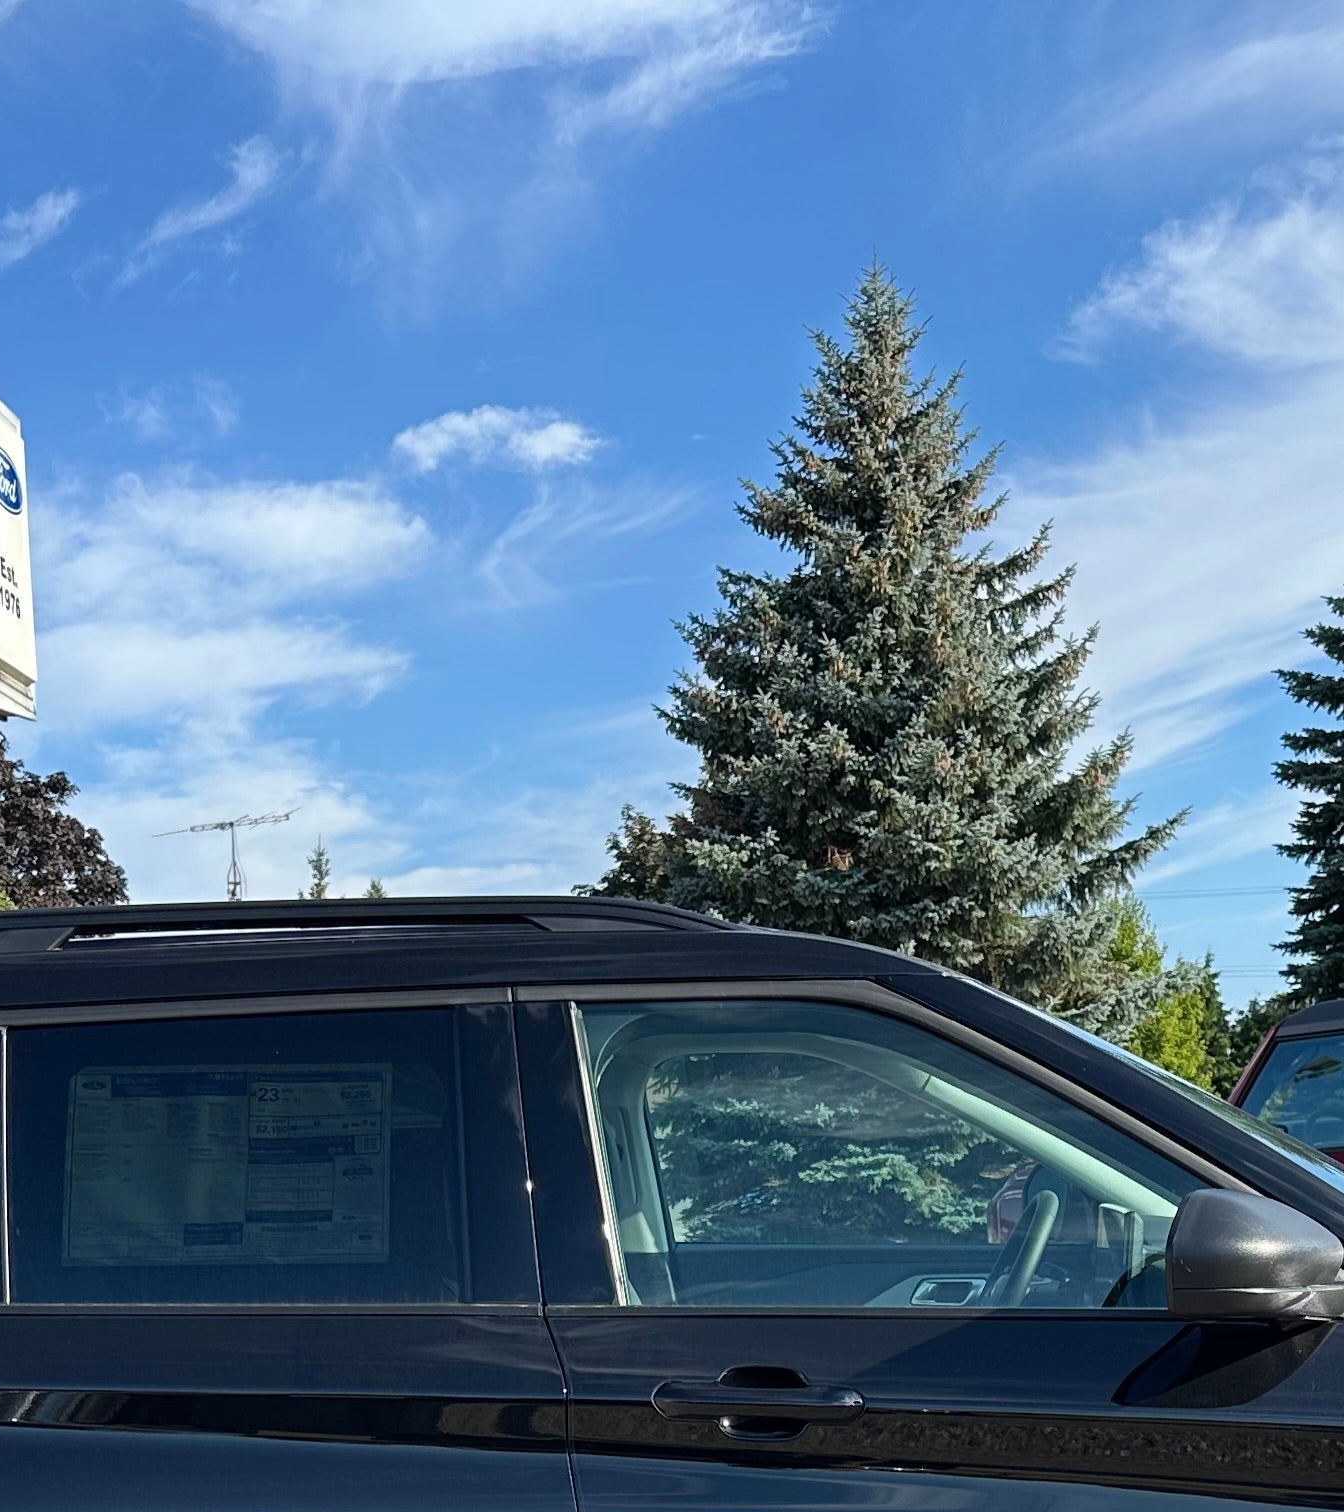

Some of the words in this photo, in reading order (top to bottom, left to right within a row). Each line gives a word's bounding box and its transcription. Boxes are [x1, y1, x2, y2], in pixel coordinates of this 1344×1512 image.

[0, 555, 19, 589] Est.
[0, 584, 21, 620] 1976
[257, 1087, 280, 1103] 23
